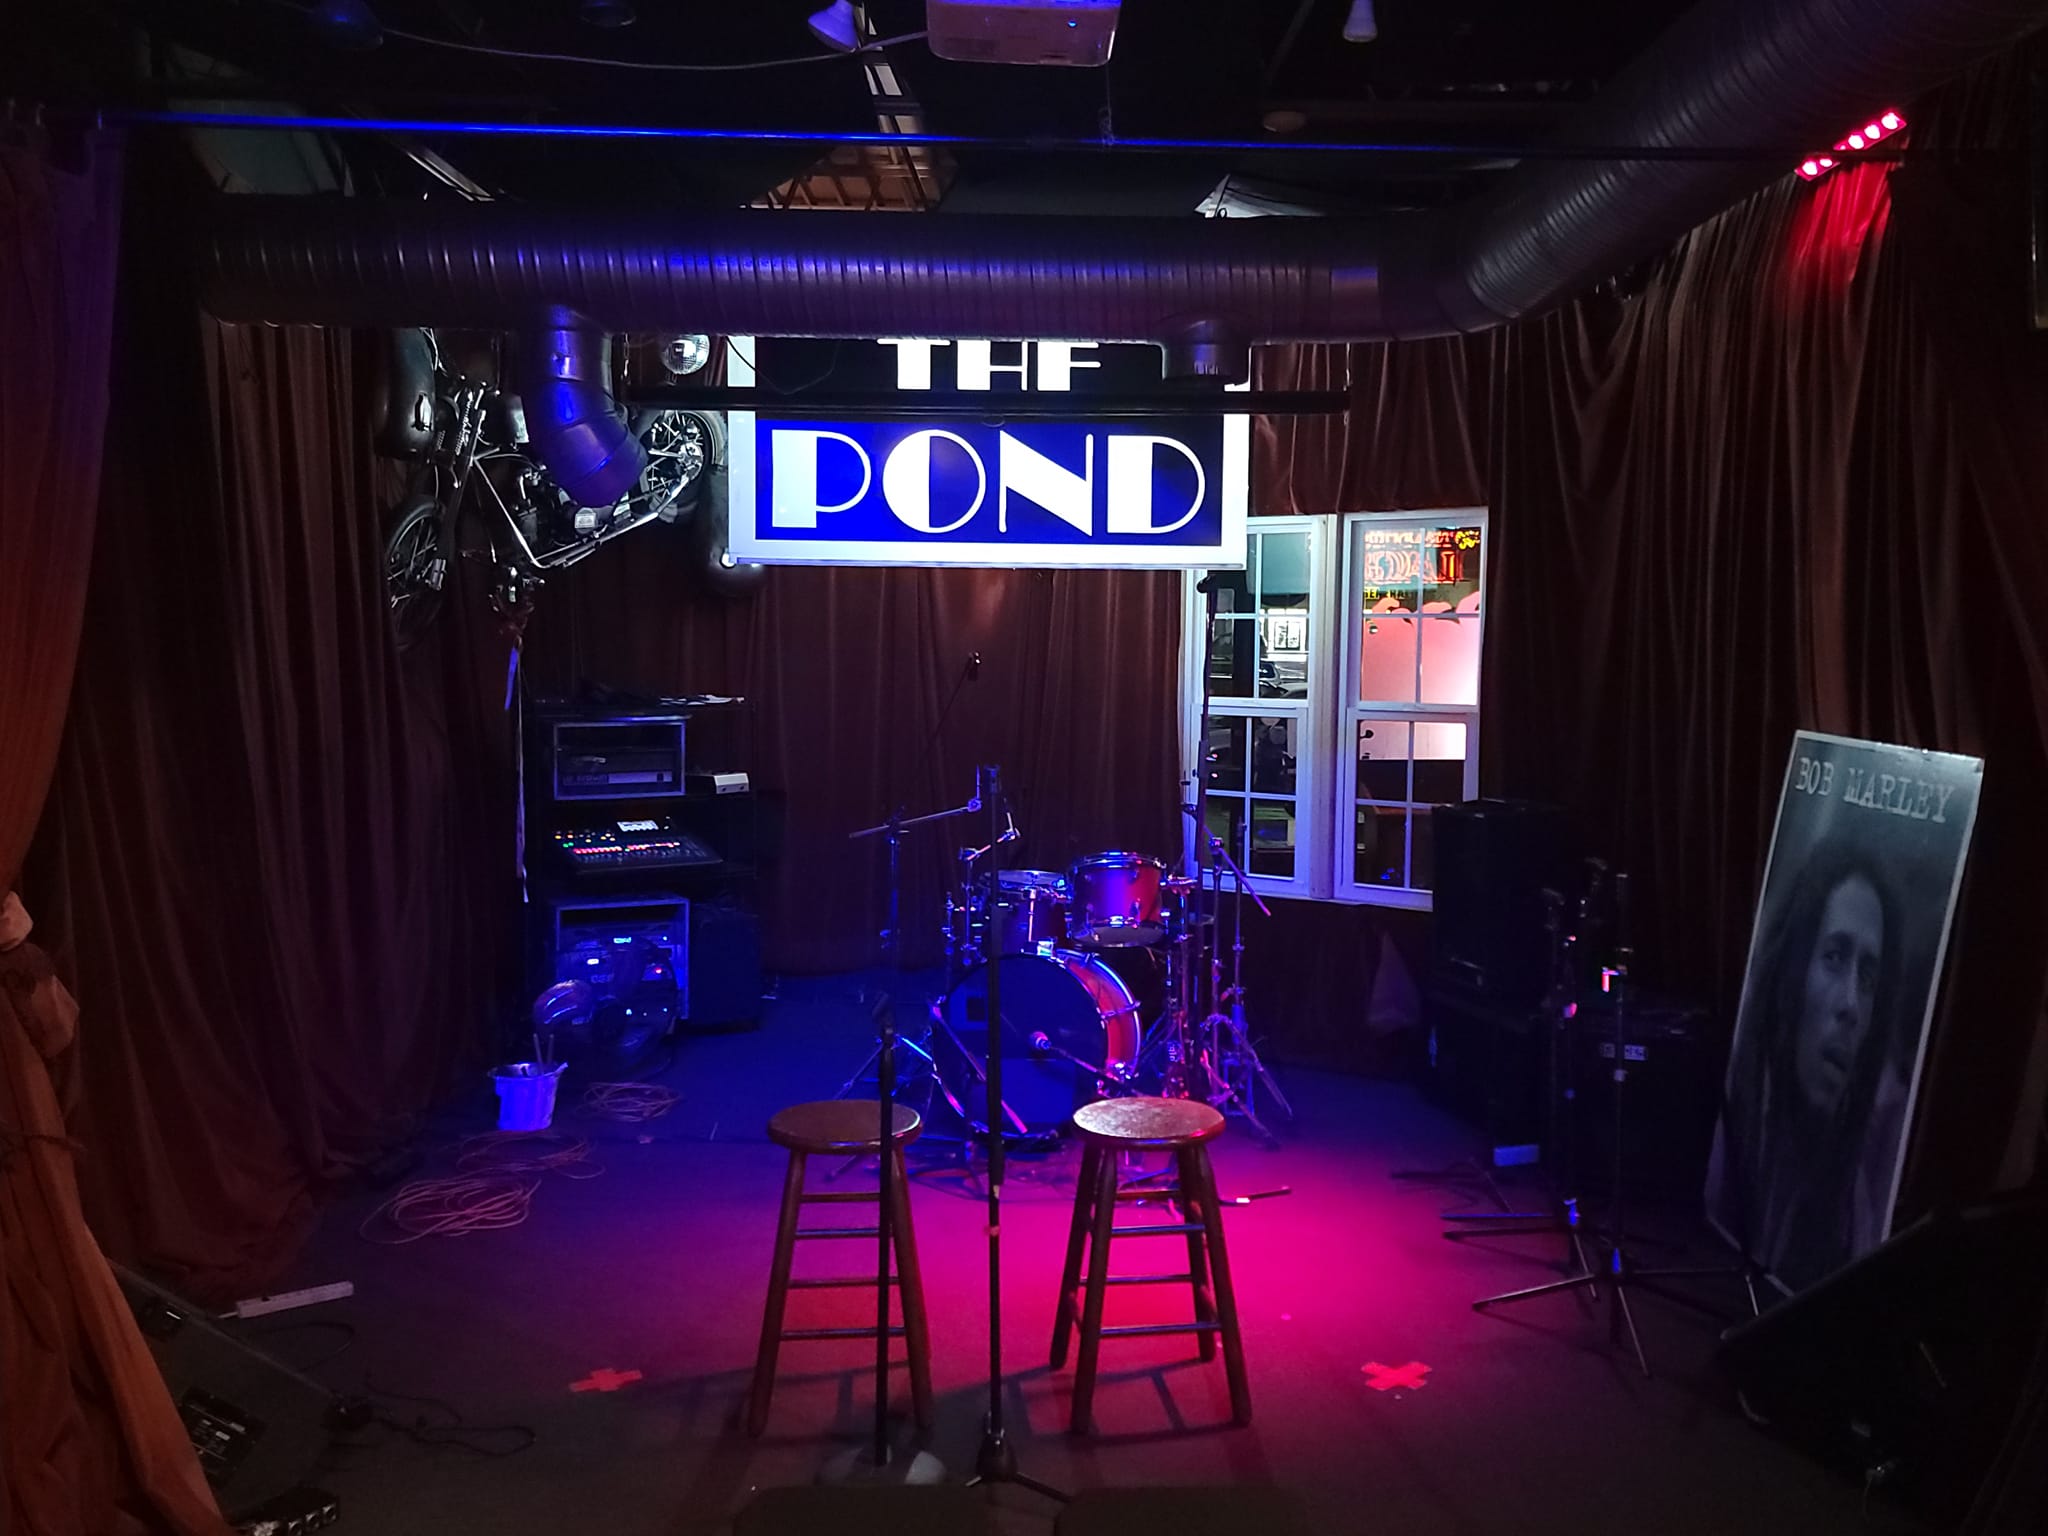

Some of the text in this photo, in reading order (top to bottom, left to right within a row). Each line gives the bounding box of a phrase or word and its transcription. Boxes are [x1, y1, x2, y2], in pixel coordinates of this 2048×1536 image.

[771, 429, 1206, 536] POND
[1795, 756, 1956, 824] BOB MARLEY
